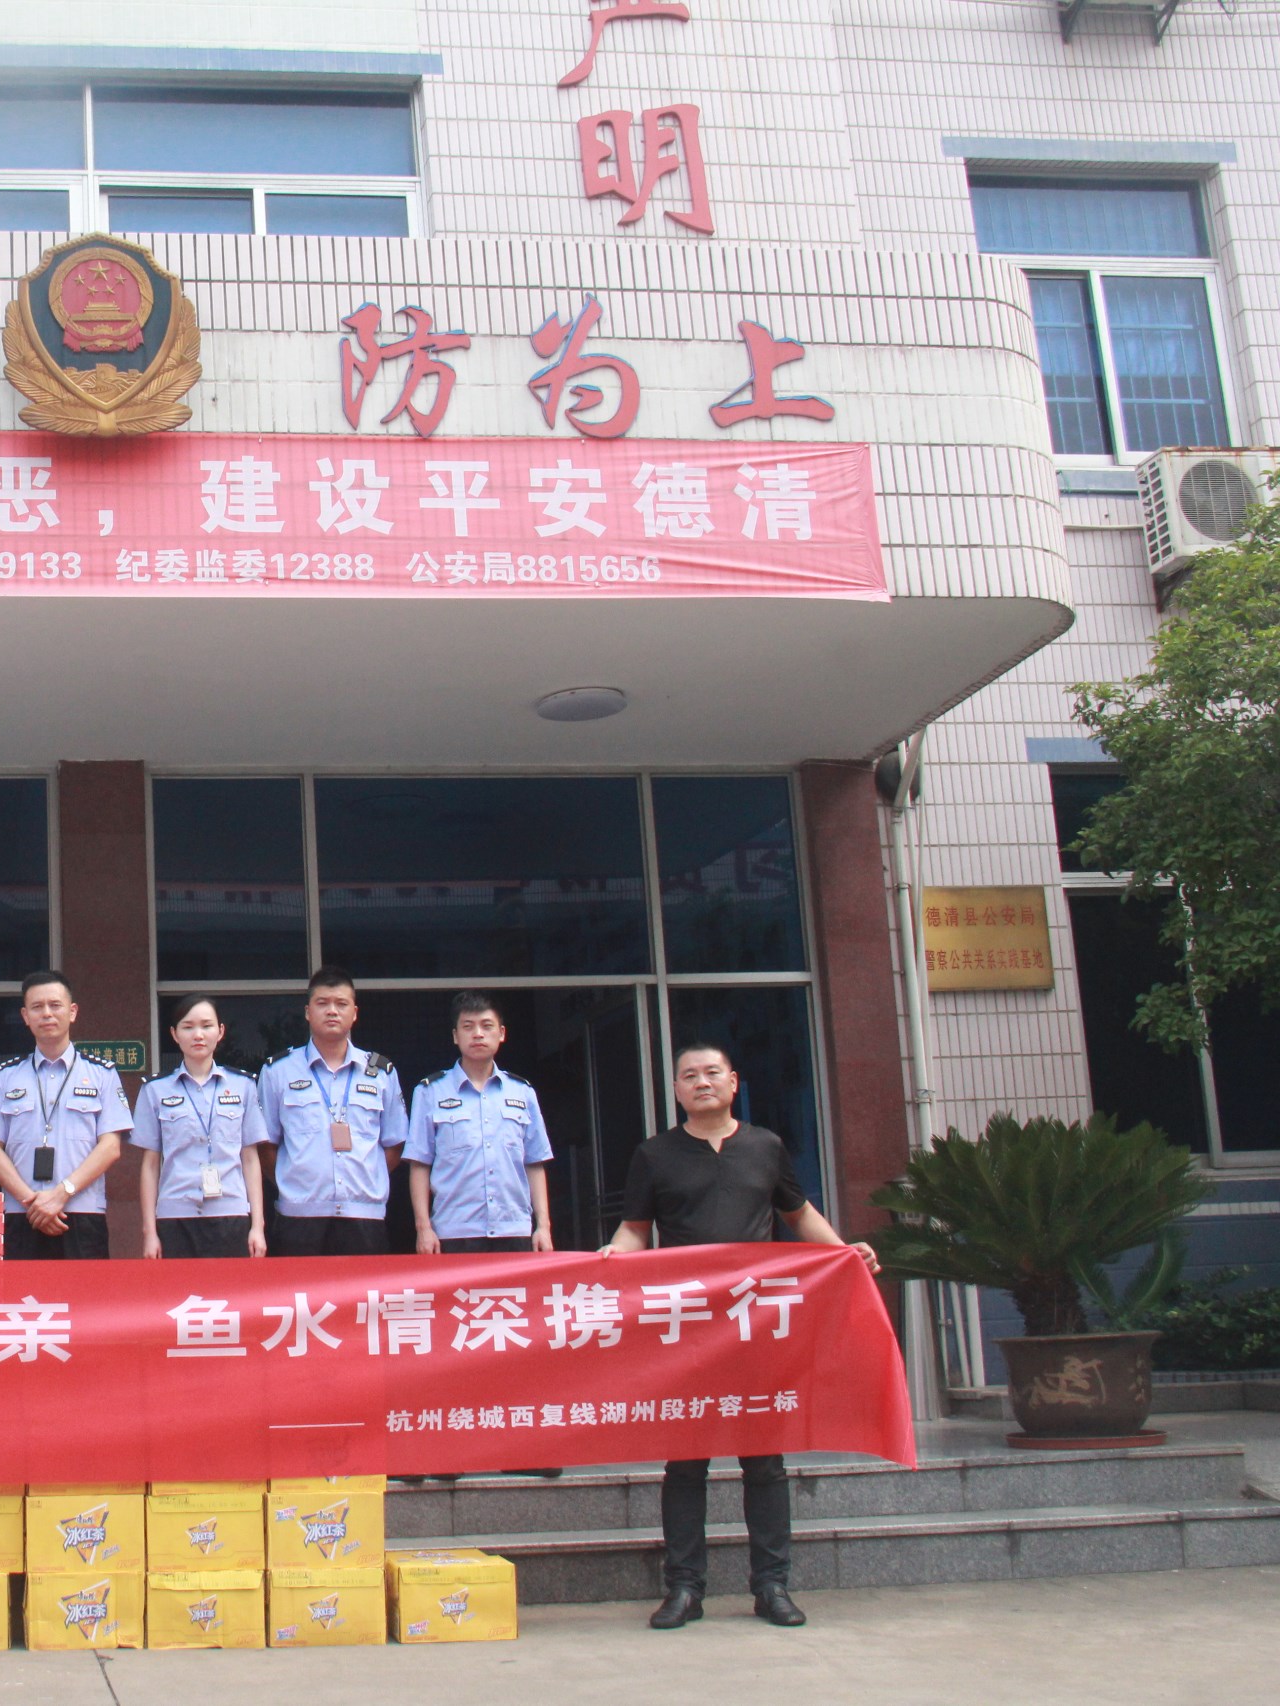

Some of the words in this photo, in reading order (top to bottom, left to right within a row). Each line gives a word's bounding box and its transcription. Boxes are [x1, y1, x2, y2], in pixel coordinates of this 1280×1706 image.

[116, 549, 374, 582] 纪委监委12388
[405, 550, 661, 584] 公安局8815656
[925, 906, 1035, 927] 德清县公安局
[166, 1276, 804, 1358] 鱼水情深携手行
[387, 1390, 799, 1433] 杭州绕城西复线湖州段扩容二标
